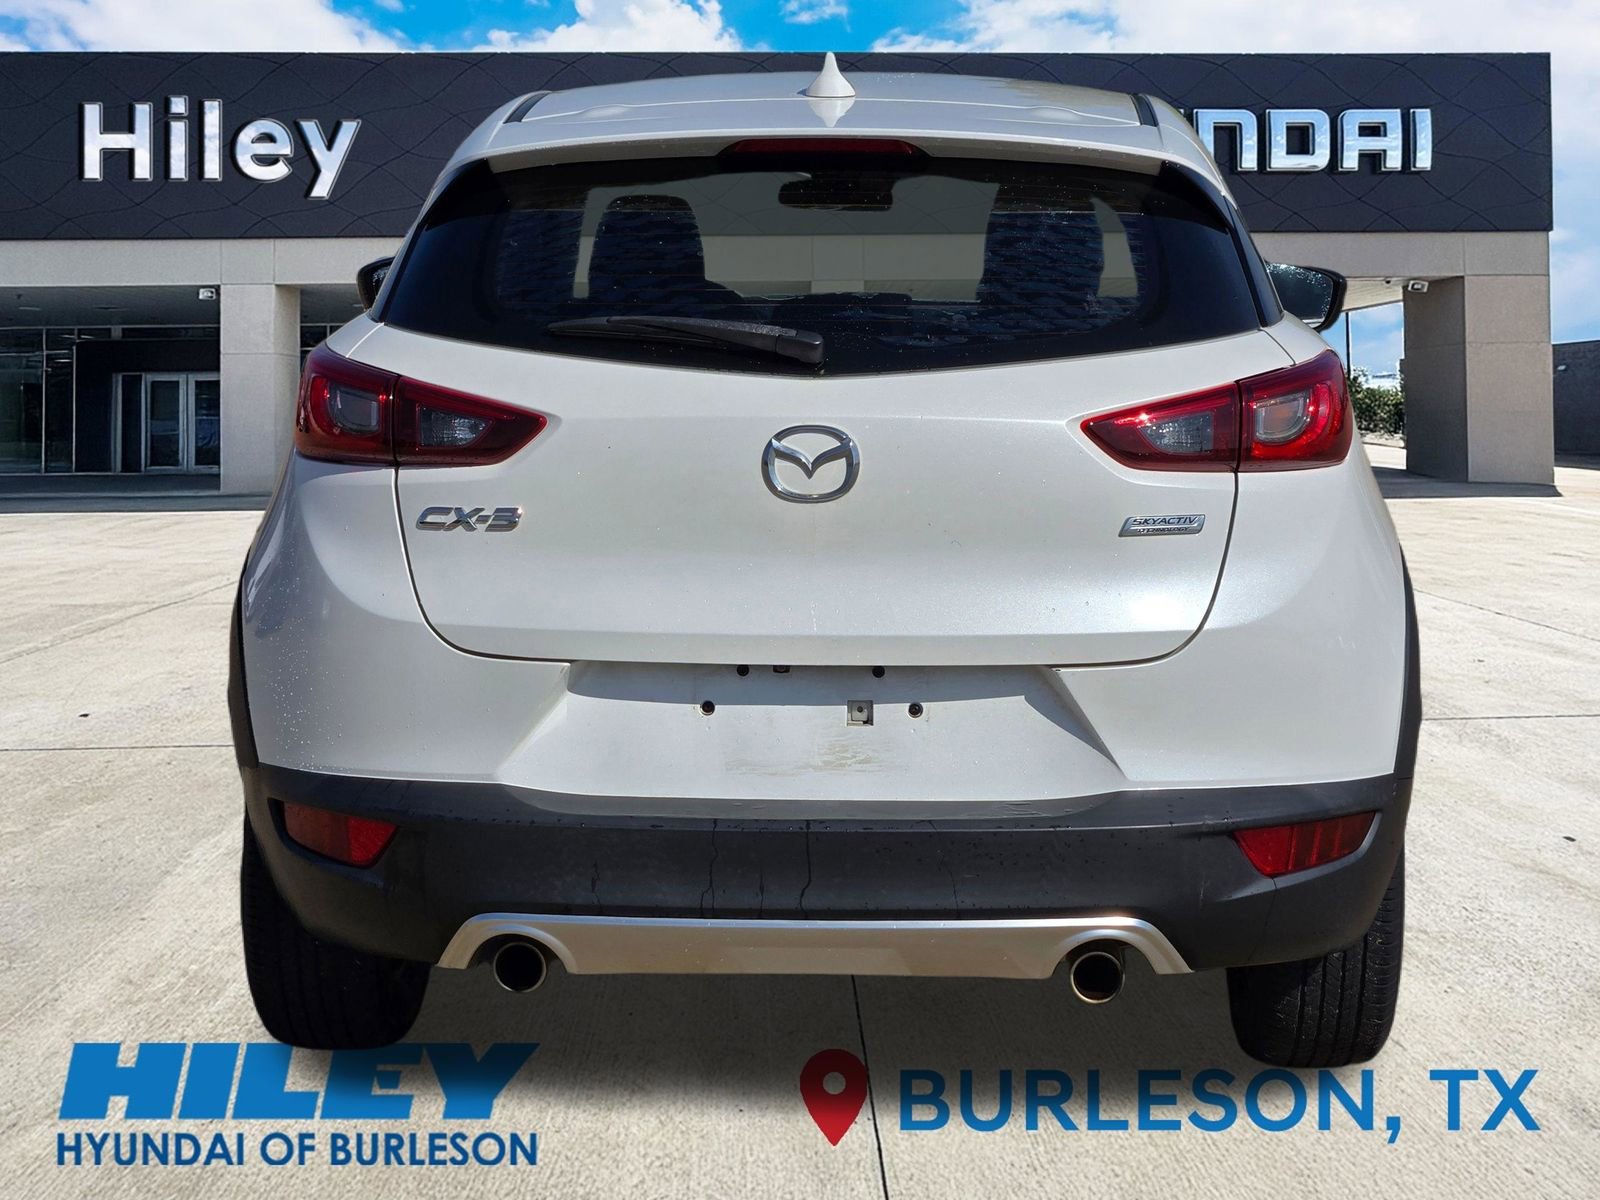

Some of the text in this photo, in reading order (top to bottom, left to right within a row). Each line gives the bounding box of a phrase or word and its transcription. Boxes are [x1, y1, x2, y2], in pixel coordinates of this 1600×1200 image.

[80, 95, 361, 200] Hiley
[1179, 108, 1432, 172] NDAI
[416, 506, 522, 532] CX-3
[1132, 516, 1198, 526] SKYACTIV
